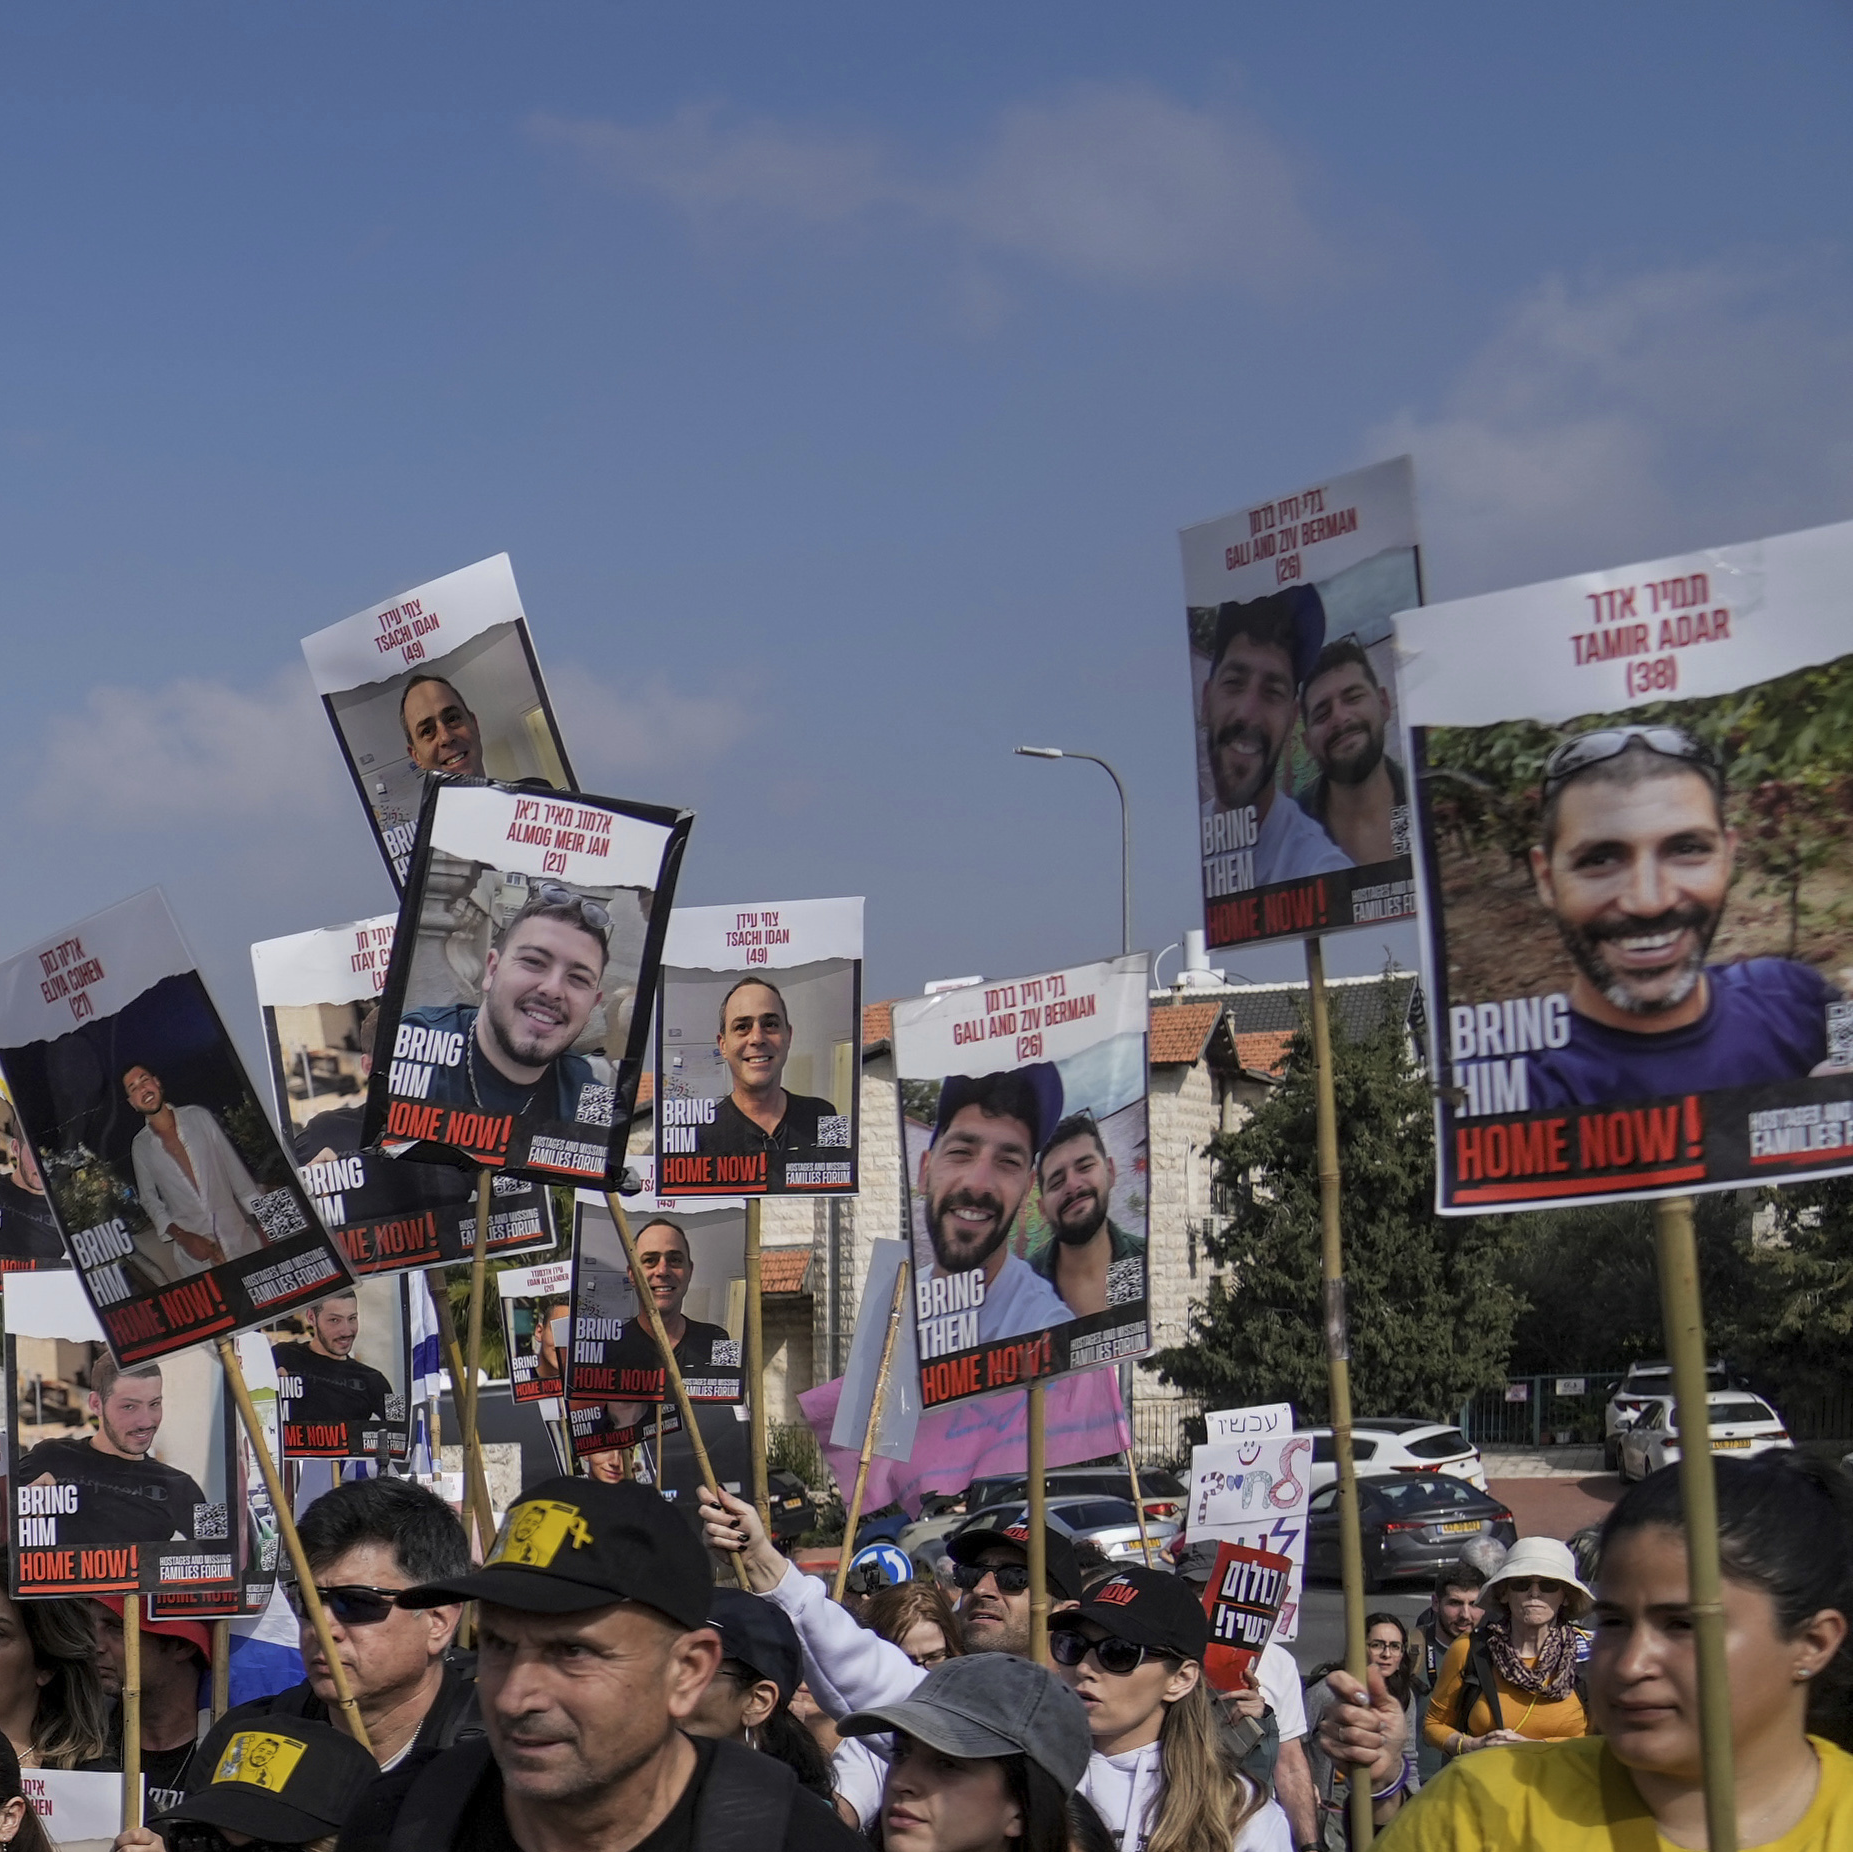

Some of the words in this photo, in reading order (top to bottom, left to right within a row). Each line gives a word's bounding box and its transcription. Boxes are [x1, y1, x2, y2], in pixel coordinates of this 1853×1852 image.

[1224, 543, 1253, 572] GALI
[1300, 506, 1359, 552] BERMAN
[1650, 572, 1710, 614] תמיר
[1571, 622, 1655, 668] TAMIR
[1657, 606, 1731, 652] ADAR
[1625, 655, 1677, 699] (38)
[506, 823, 551, 847] ALMOG
[554, 830, 584, 852] MEIR
[588, 837, 611, 858] JAN
[543, 853, 568, 875] (21)
[725, 928, 762, 948] TSACHI
[764, 926, 789, 946] IDAN
[745, 946, 768, 965] (49)
[69, 991, 94, 1022] (27)
[953, 1018, 986, 1047] GALI
[1019, 1007, 1042, 1034] ZIV
[1043, 994, 1097, 1029] BERMAN
[1449, 992, 1572, 1061] BRING
[394, 1023, 464, 1068] BRING
[1015, 1032, 1043, 1061] (26)
[1453, 1056, 1530, 1119] HIM
[445, 1111, 513, 1153] NOW!
[661, 1125, 697, 1154] HIM
[1455, 1106, 1571, 1182] HOME
[1575, 1095, 1705, 1172] NOW!
[715, 1152, 767, 1182] NOW!
[917, 1268, 986, 1313] BRING
[917, 1311, 980, 1363] THEM
[1218, 1413, 1278, 1436] עכשיו
[18, 1484, 78, 1517] BRING
[18, 1516, 57, 1548] HIM
[19, 1548, 76, 1582] HOME
[79, 1545, 140, 1578] NOW!
[159, 1554, 190, 1568] HOSTAGES
[204, 1553, 232, 1567] MISSING
[159, 1566, 199, 1582] FAMILIES
[200, 1564, 232, 1580] FORUM
[1097, 1584, 1139, 1605] NOW
